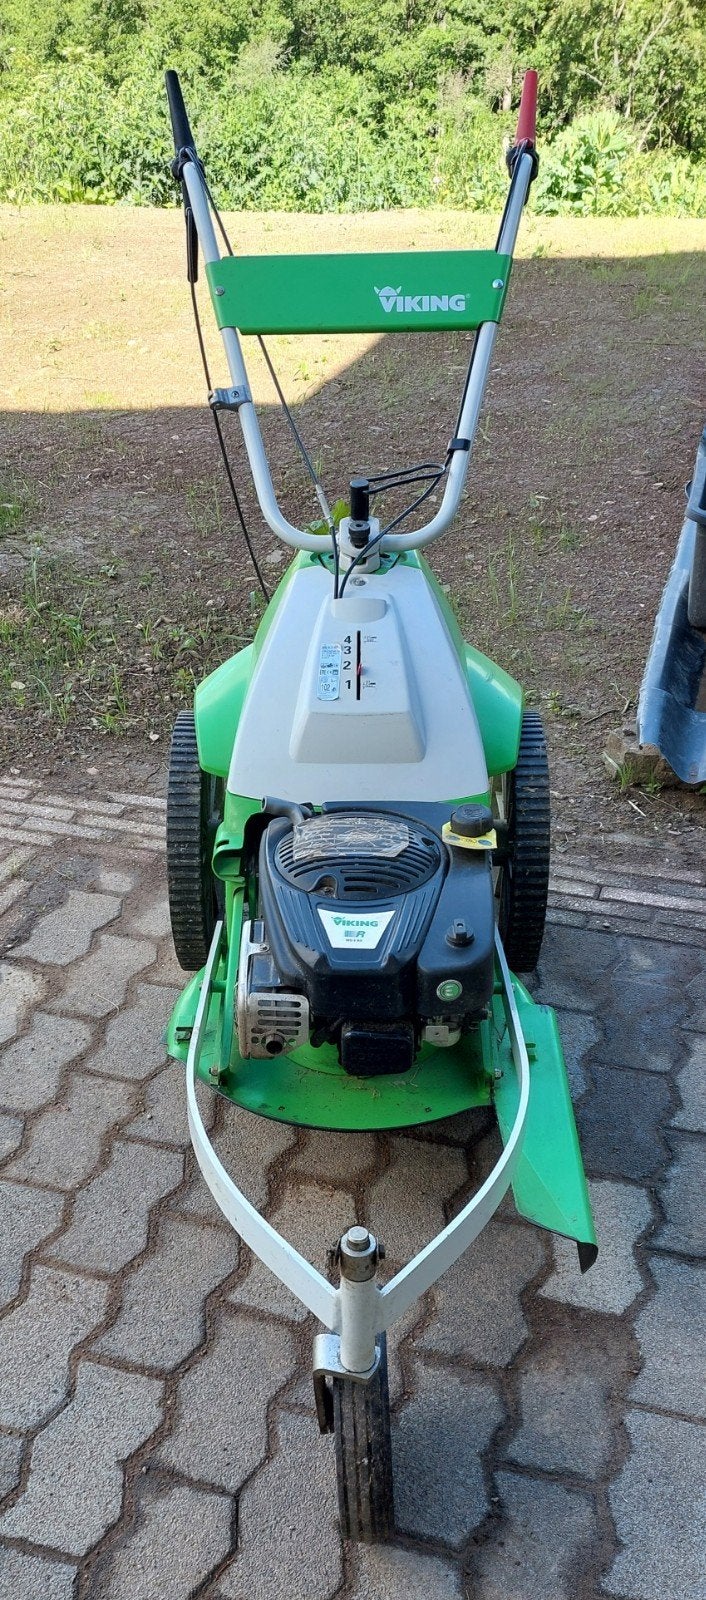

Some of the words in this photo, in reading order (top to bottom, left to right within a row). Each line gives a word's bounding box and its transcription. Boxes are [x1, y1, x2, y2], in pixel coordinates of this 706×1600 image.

[379, 294, 466, 312] VIKING
[344, 635, 352, 643] 4
[344, 646, 352, 654] 3
[343, 661, 352, 670] 2
[345, 680, 352, 689] 1
[333, 917, 379, 927] VIKING
